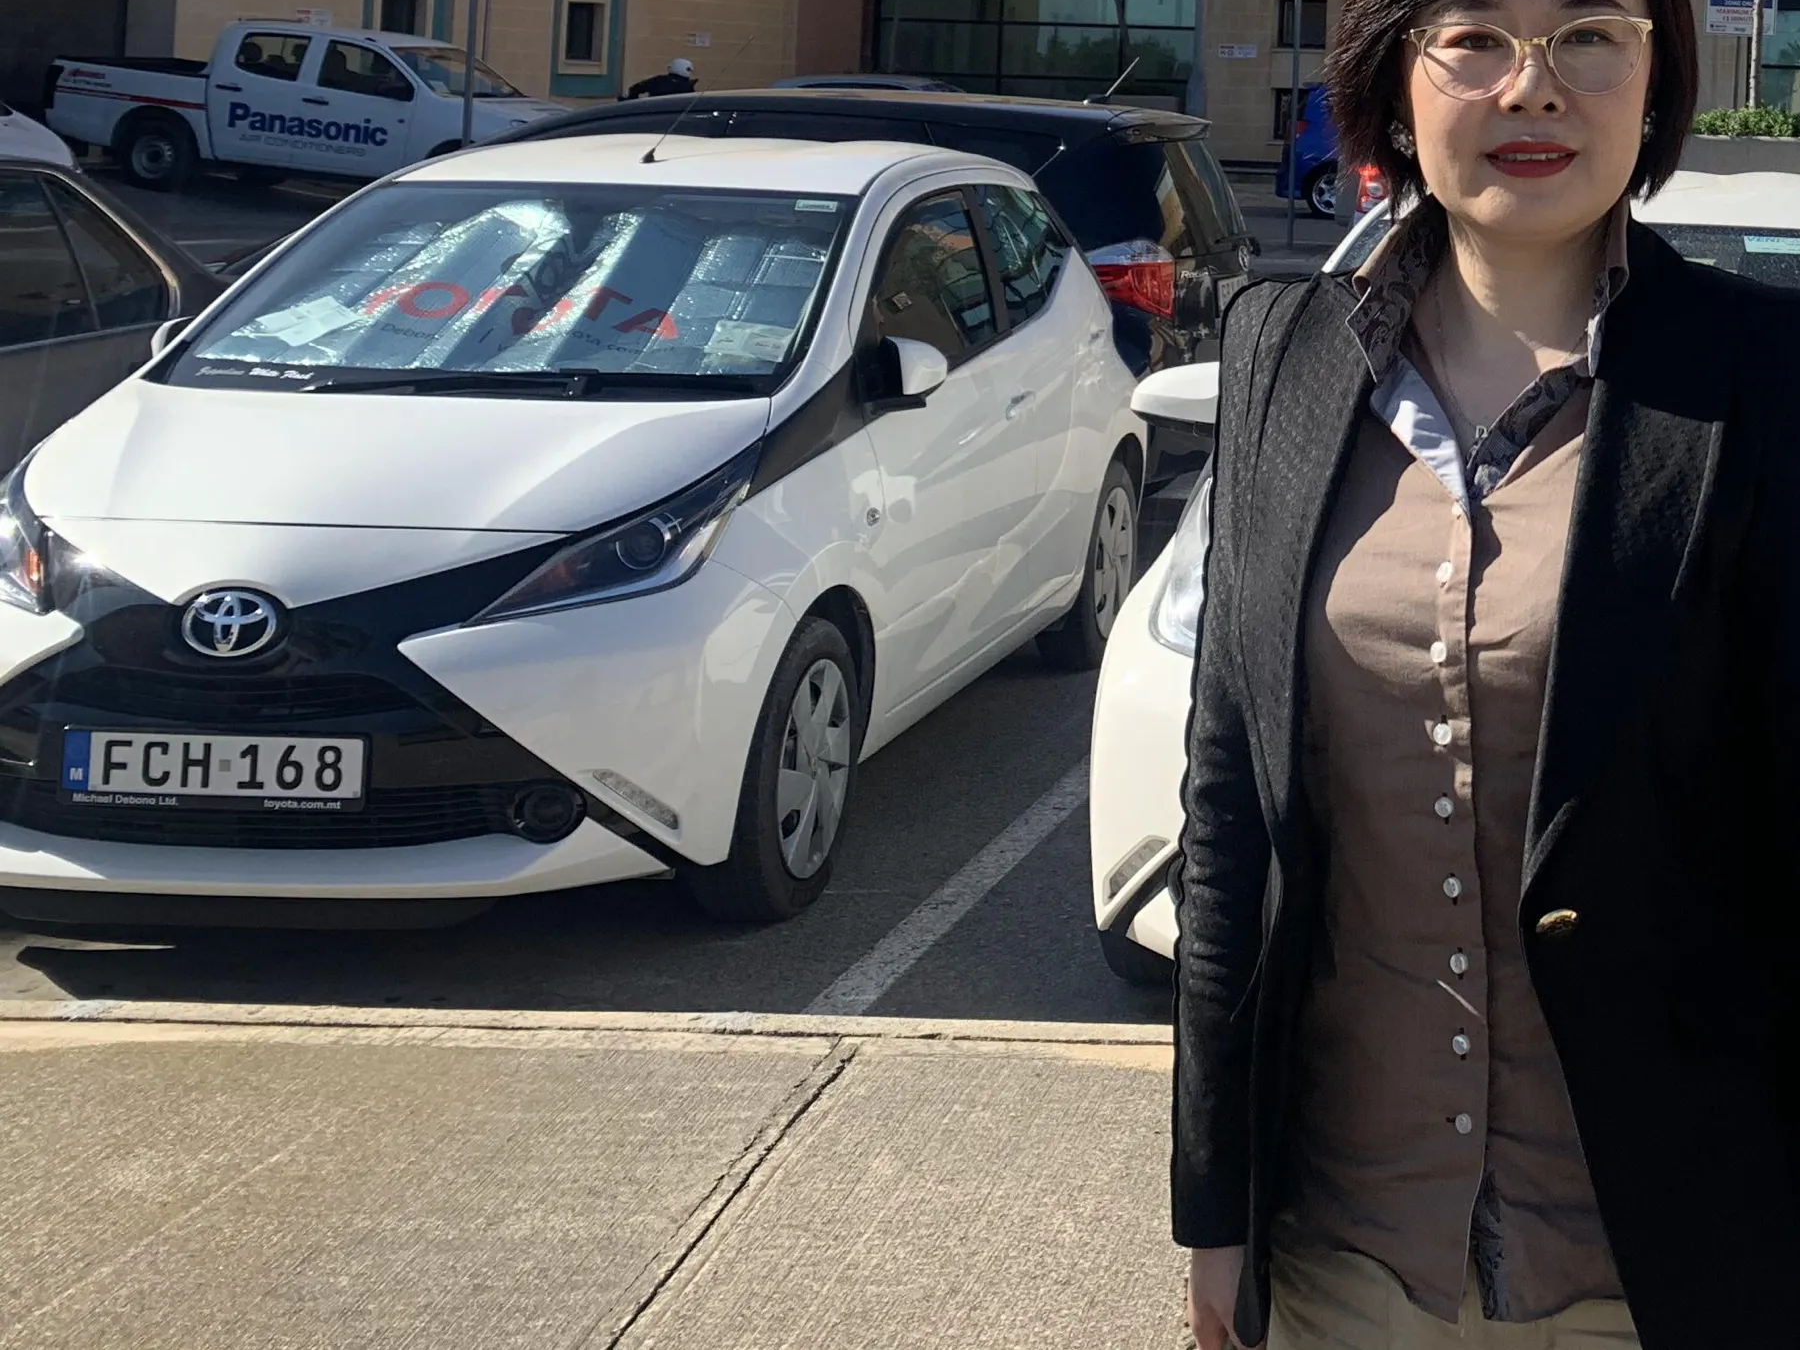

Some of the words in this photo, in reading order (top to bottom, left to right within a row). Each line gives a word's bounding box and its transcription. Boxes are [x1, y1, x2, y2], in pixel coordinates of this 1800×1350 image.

[227, 102, 388, 147] Panasonic
[239, 134, 262, 143] AIR
[263, 136, 367, 158] CONDITIONERS
[69, 767, 84, 781] M
[102, 739, 212, 788] FCH
[236, 744, 343, 792] 168
[72, 792, 113, 804] Michael
[115, 794, 157, 805] Debono
[158, 795, 179, 806] Ltd.
[263, 798, 342, 810] toyota.com.mt
